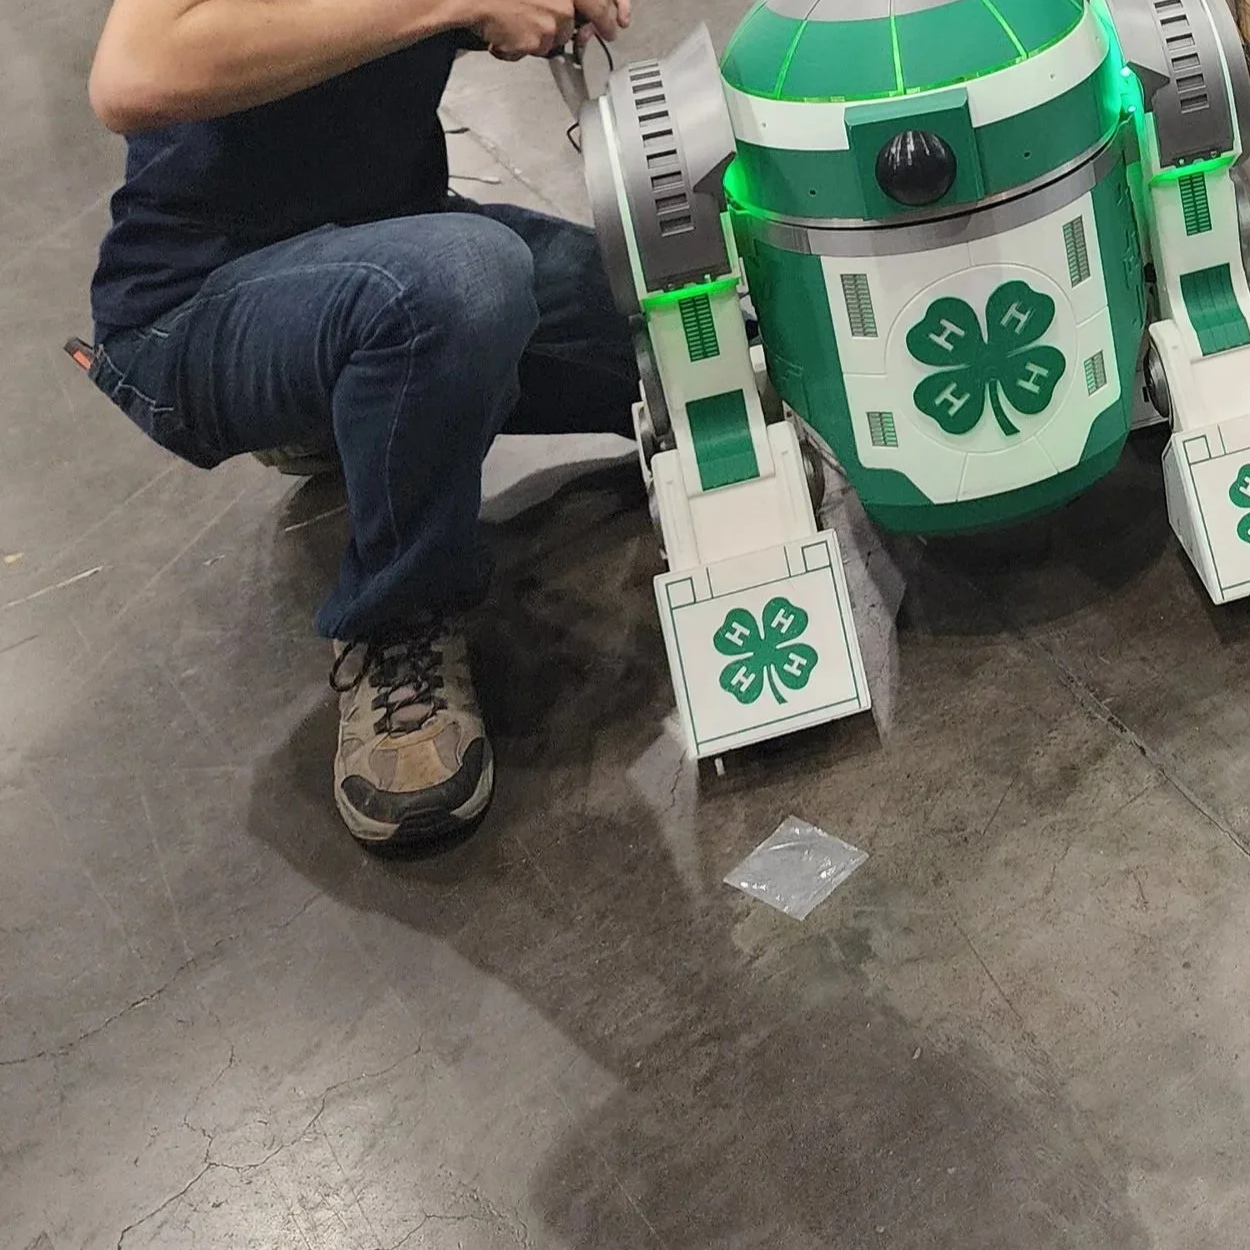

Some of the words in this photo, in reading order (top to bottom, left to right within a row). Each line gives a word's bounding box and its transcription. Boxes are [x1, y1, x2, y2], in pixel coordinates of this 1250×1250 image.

[1000, 301, 1032, 334] H
[928, 318, 965, 351] H
[1016, 362, 1049, 394] H
[934, 382, 971, 417] H
[725, 621, 750, 646] H
[771, 608, 794, 634] H
[730, 666, 755, 692] H
[783, 653, 807, 677] H
